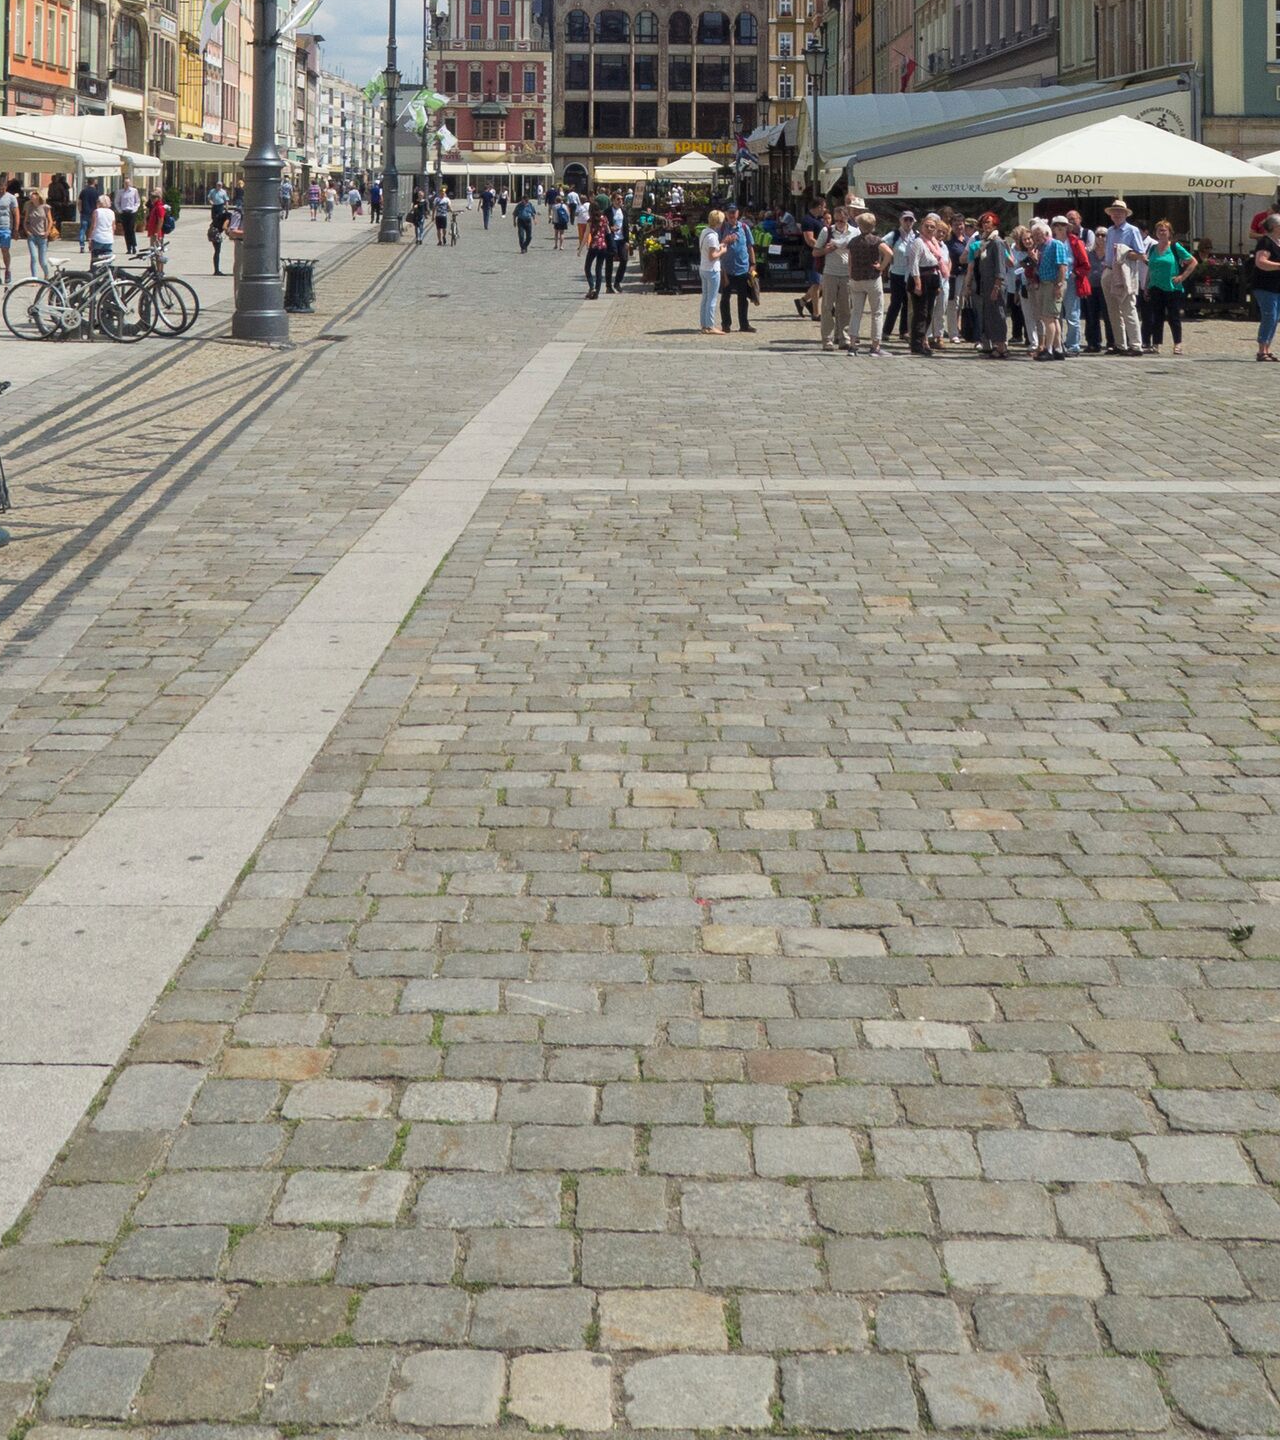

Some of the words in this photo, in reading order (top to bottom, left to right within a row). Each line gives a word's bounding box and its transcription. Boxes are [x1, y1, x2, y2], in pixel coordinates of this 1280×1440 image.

[1056, 174, 1103, 185] BADOIT
[1187, 177, 1236, 189] BADOIT
[869, 183, 897, 194] TYSKIE
